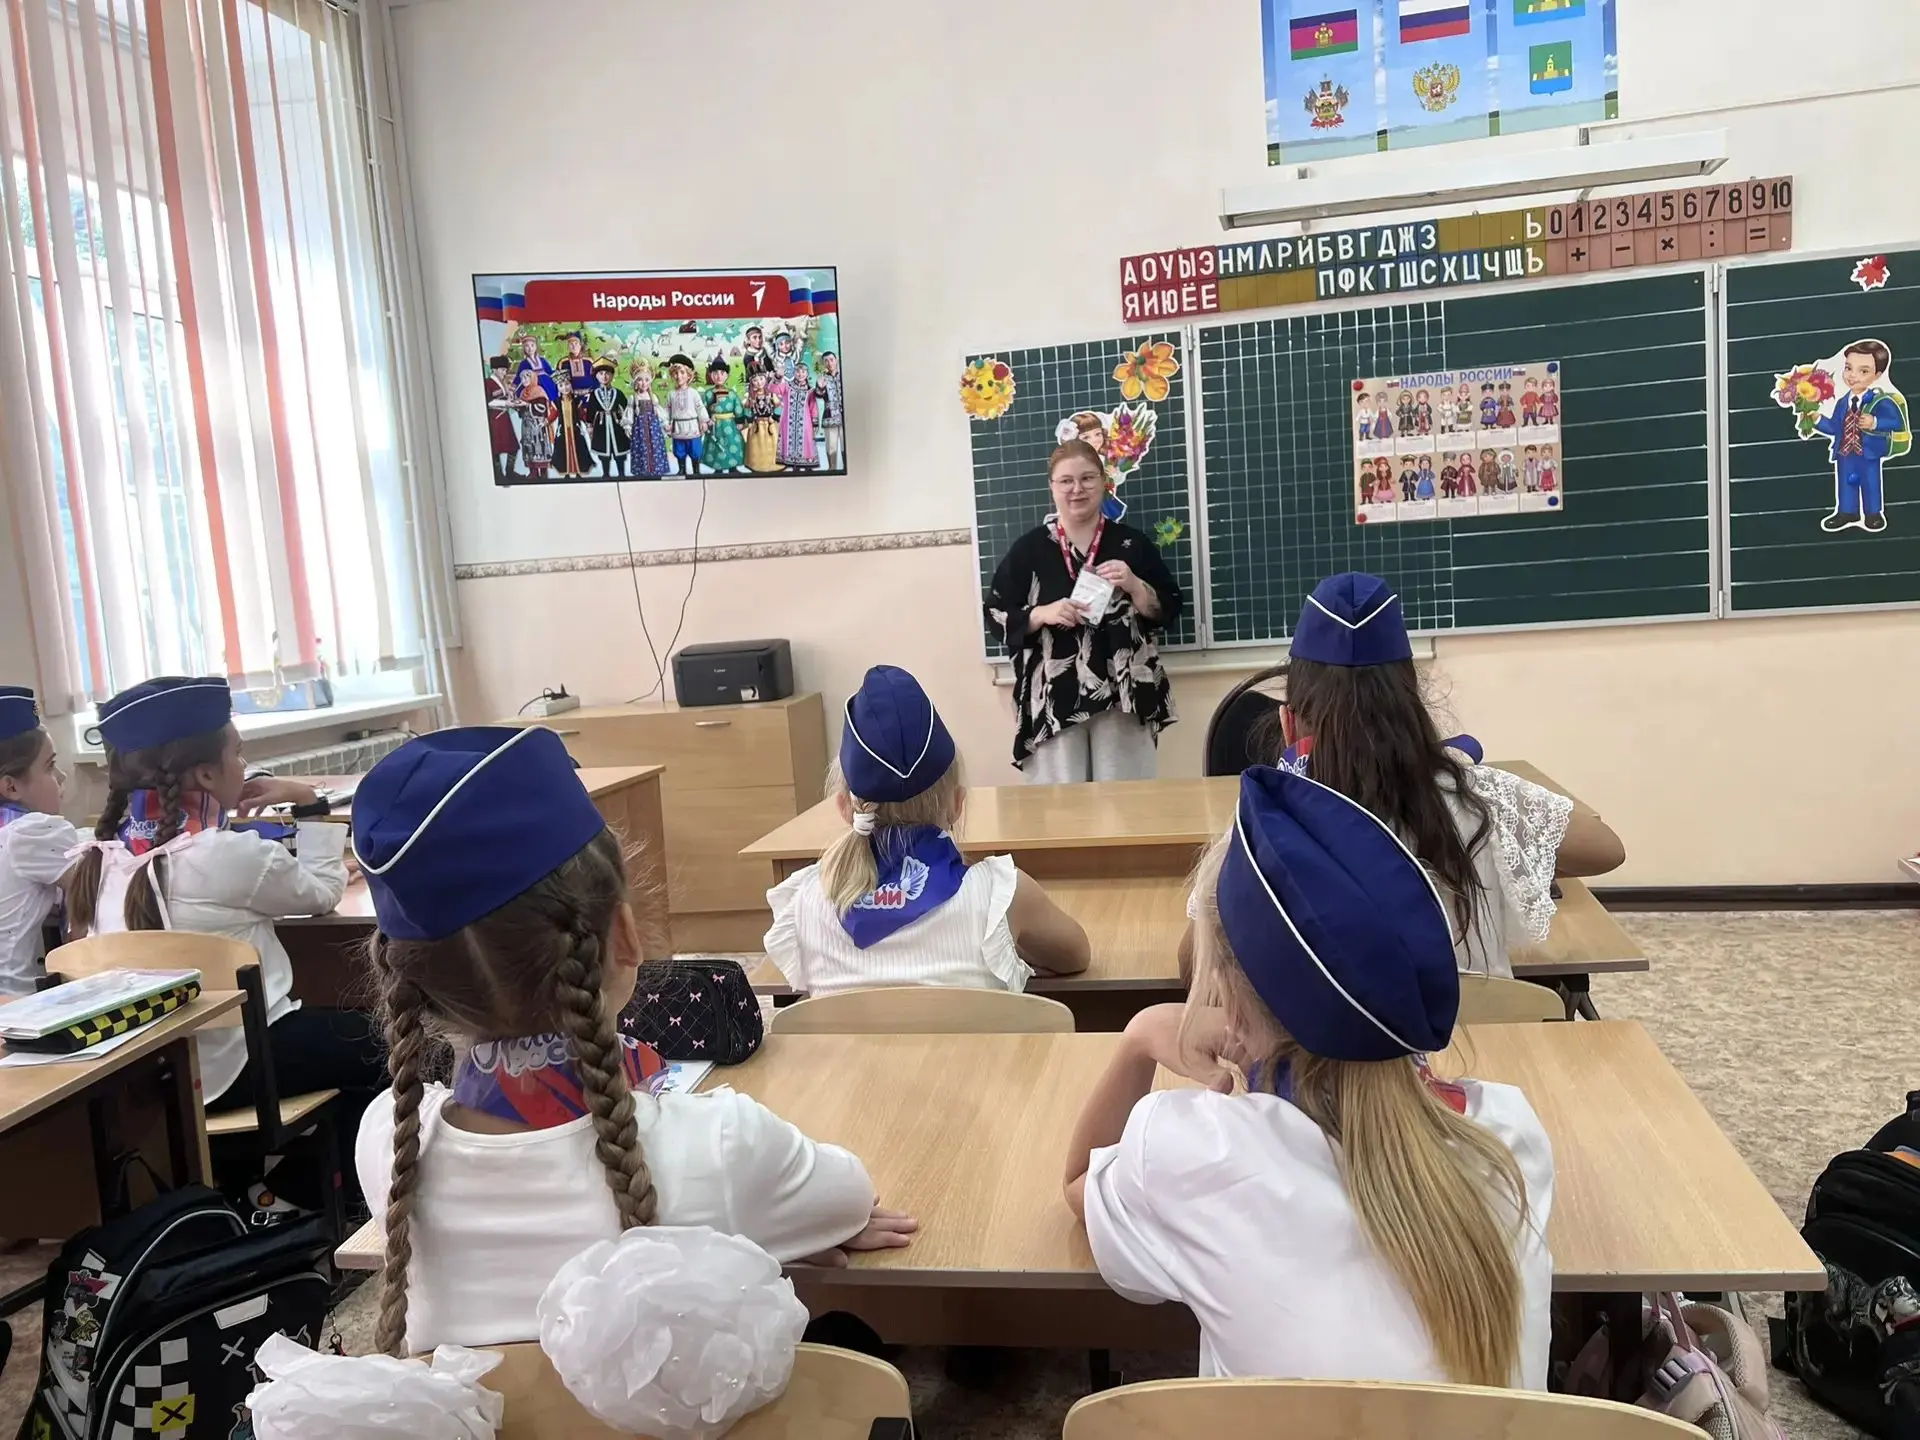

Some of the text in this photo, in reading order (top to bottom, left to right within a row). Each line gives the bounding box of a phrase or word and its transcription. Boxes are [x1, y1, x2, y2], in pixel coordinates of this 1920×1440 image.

[592, 292, 735, 311] Народы России
[1400, 367, 1513, 389] НАРОДЫ РОССИИ
